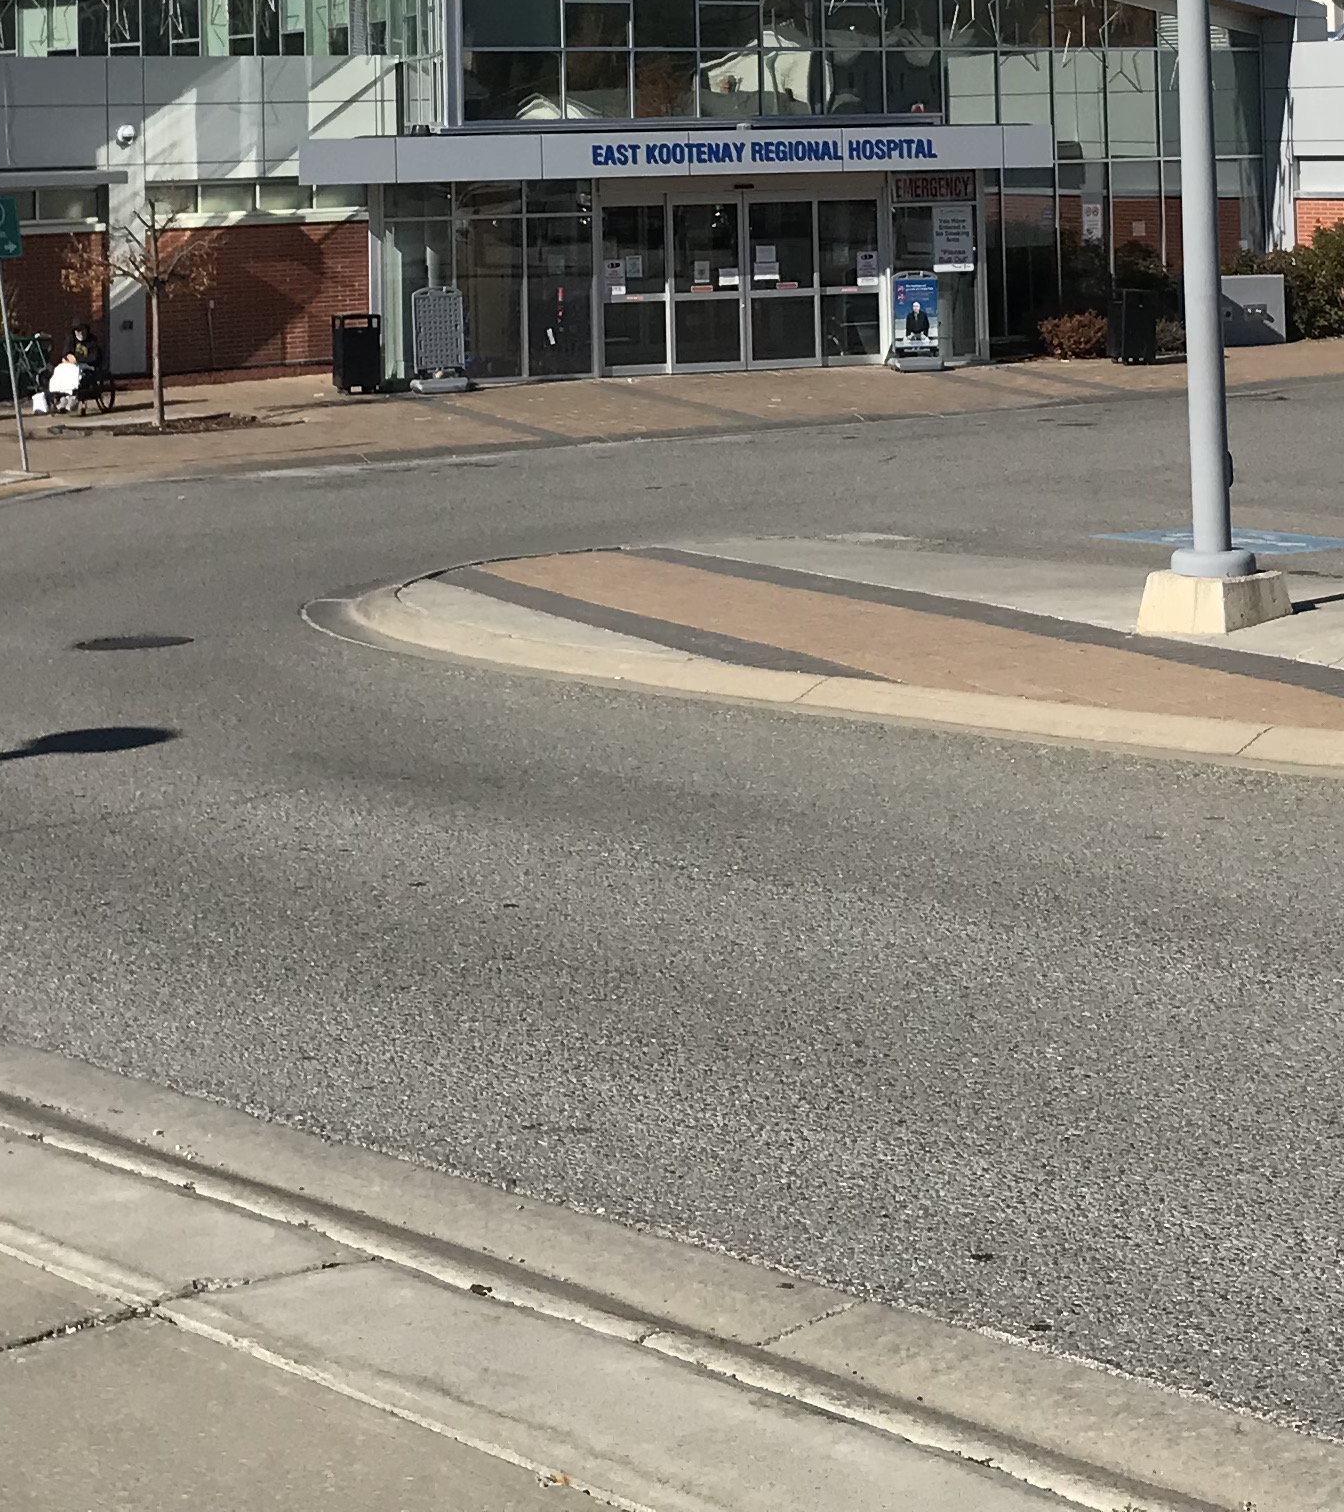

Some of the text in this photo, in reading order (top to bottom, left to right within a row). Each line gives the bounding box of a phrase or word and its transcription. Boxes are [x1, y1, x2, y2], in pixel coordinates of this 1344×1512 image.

[592, 138, 938, 166] EAST KOOTENAY REGIONAL HOSPITAL
[895, 176, 970, 198] EMERGENCY
